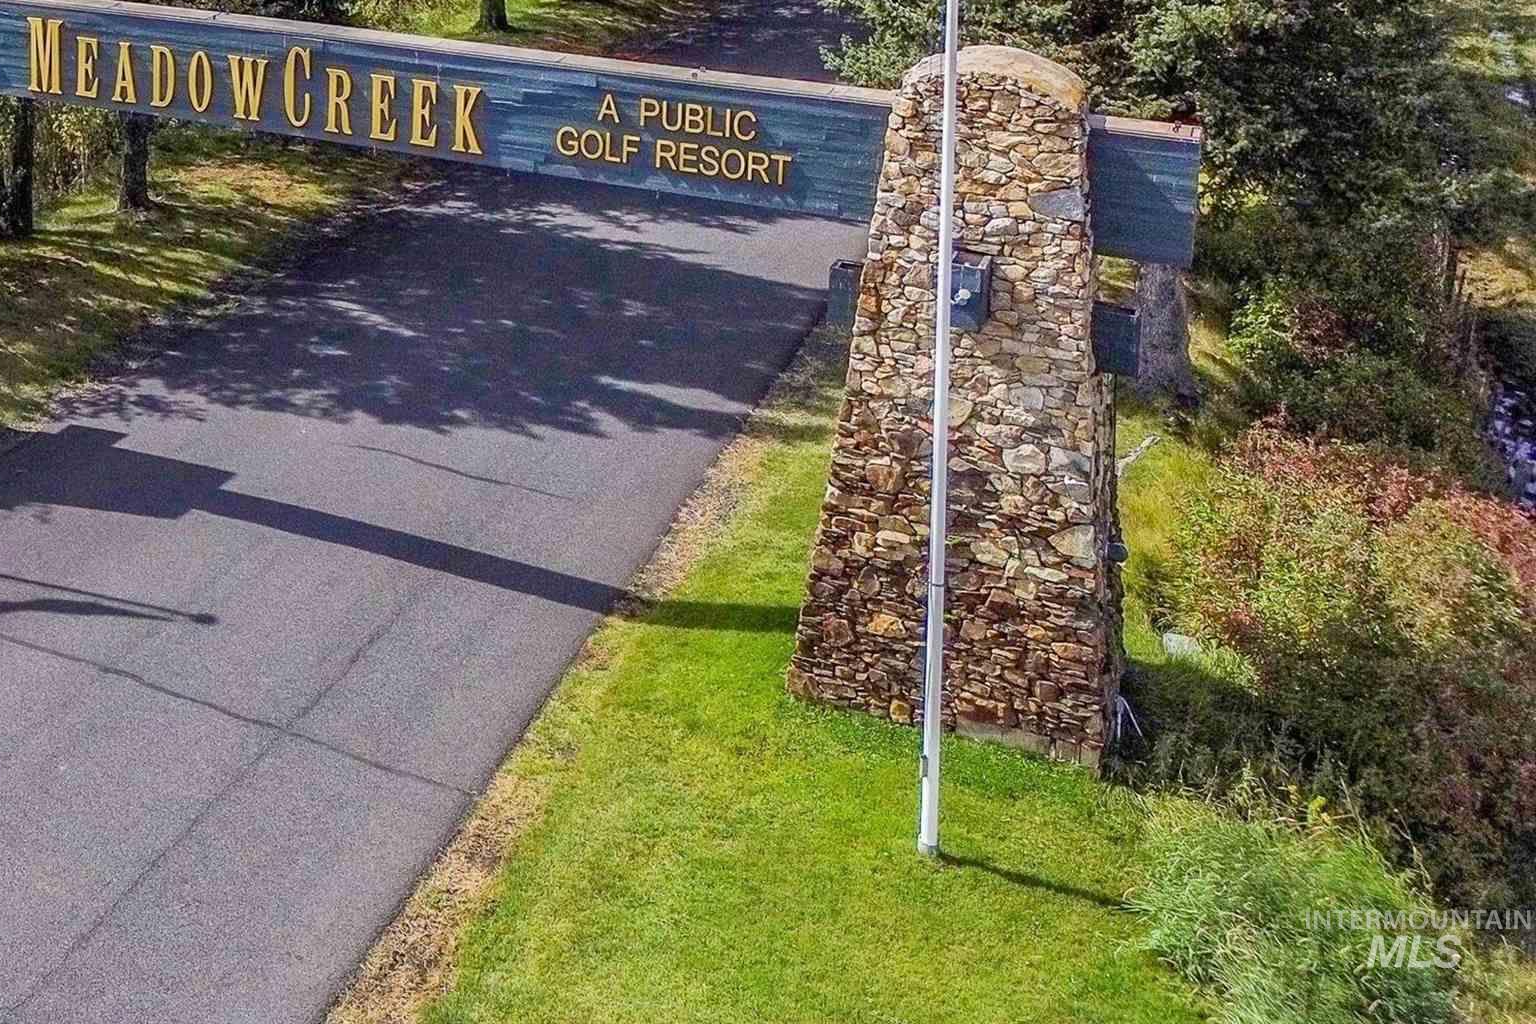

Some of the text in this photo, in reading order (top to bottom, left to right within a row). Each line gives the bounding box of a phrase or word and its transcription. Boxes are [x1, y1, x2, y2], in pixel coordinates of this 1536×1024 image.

[597, 93, 758, 142] A PUBLIC
[556, 126, 793, 186] GOLF RESORT
